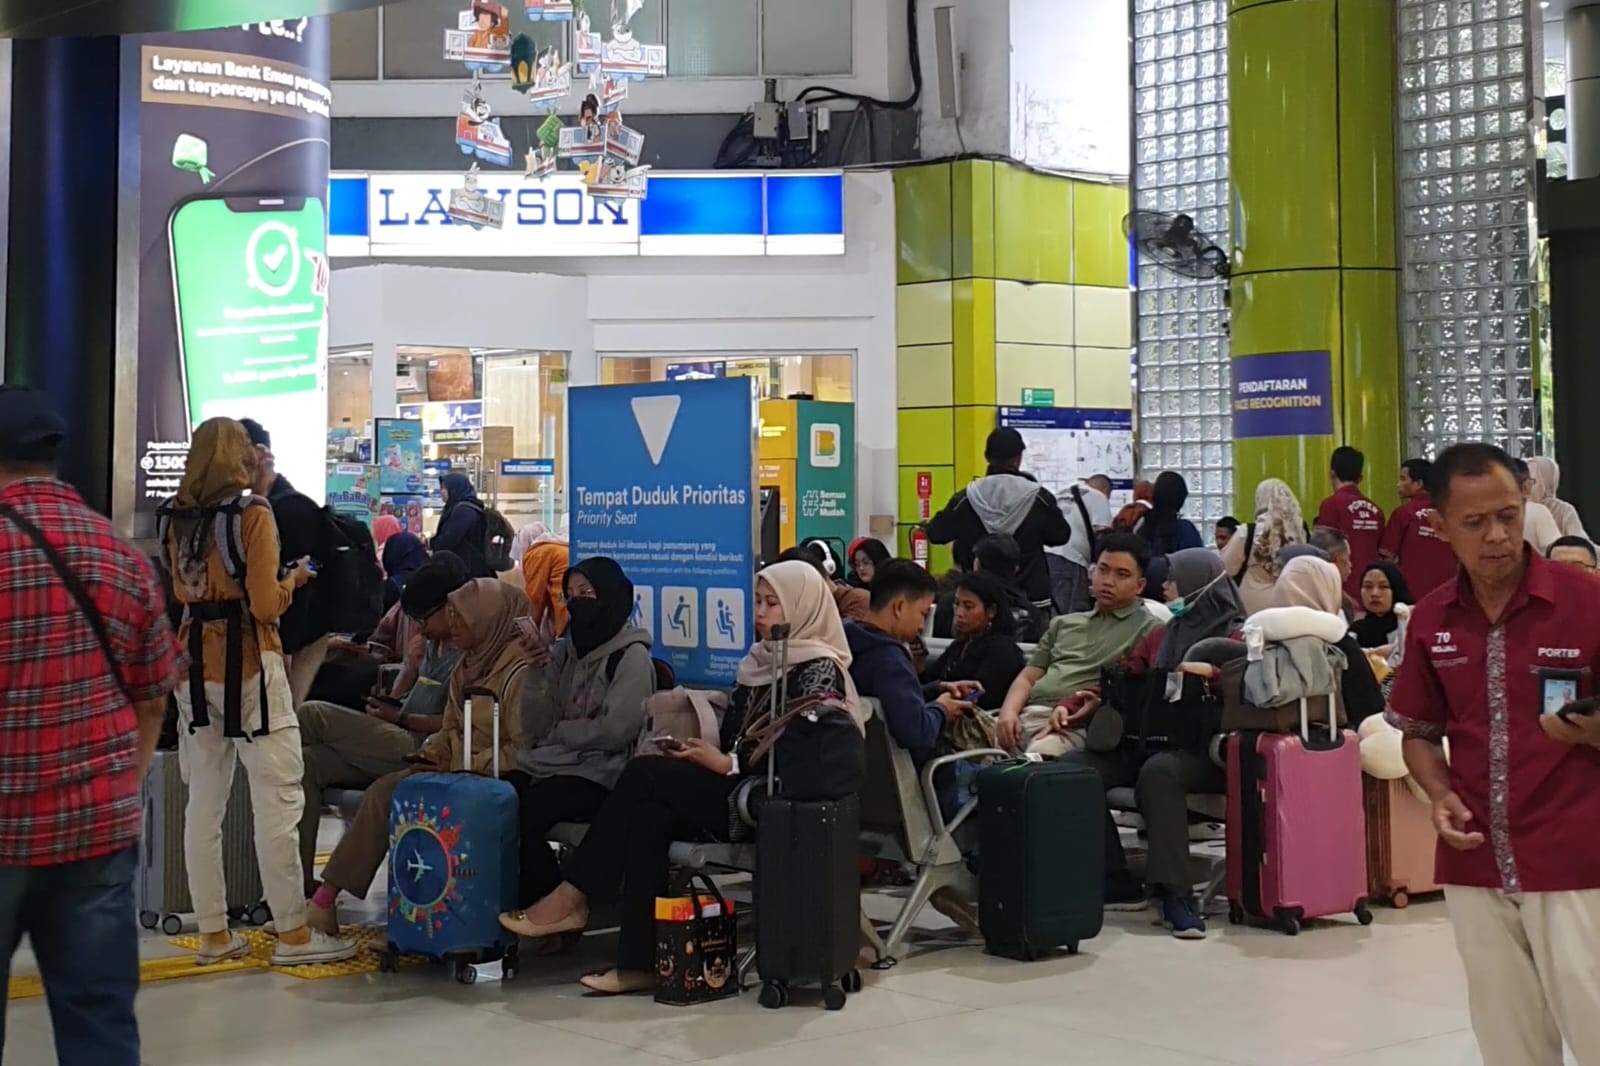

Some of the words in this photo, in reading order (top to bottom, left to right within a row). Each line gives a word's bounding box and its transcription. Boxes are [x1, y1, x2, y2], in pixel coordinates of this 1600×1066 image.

[153, 55, 222, 74] Layanan
[224, 61, 261, 80] Bank
[152, 75, 184, 92] dan
[187, 77, 268, 102] terpercaya
[379, 188, 629, 226] LASON
[1238, 379, 1308, 393] PENDAFTARAN
[1249, 395, 1322, 409] RECOGNITION
[577, 486, 628, 509] Tempat
[632, 485, 679, 505] Duduk
[683, 484, 746, 505] Prioritas
[577, 510, 612, 527] Priority
[614, 511, 638, 525] Seat
[1435, 632, 1451, 644] 70
[1537, 647, 1581, 659] PORTER
